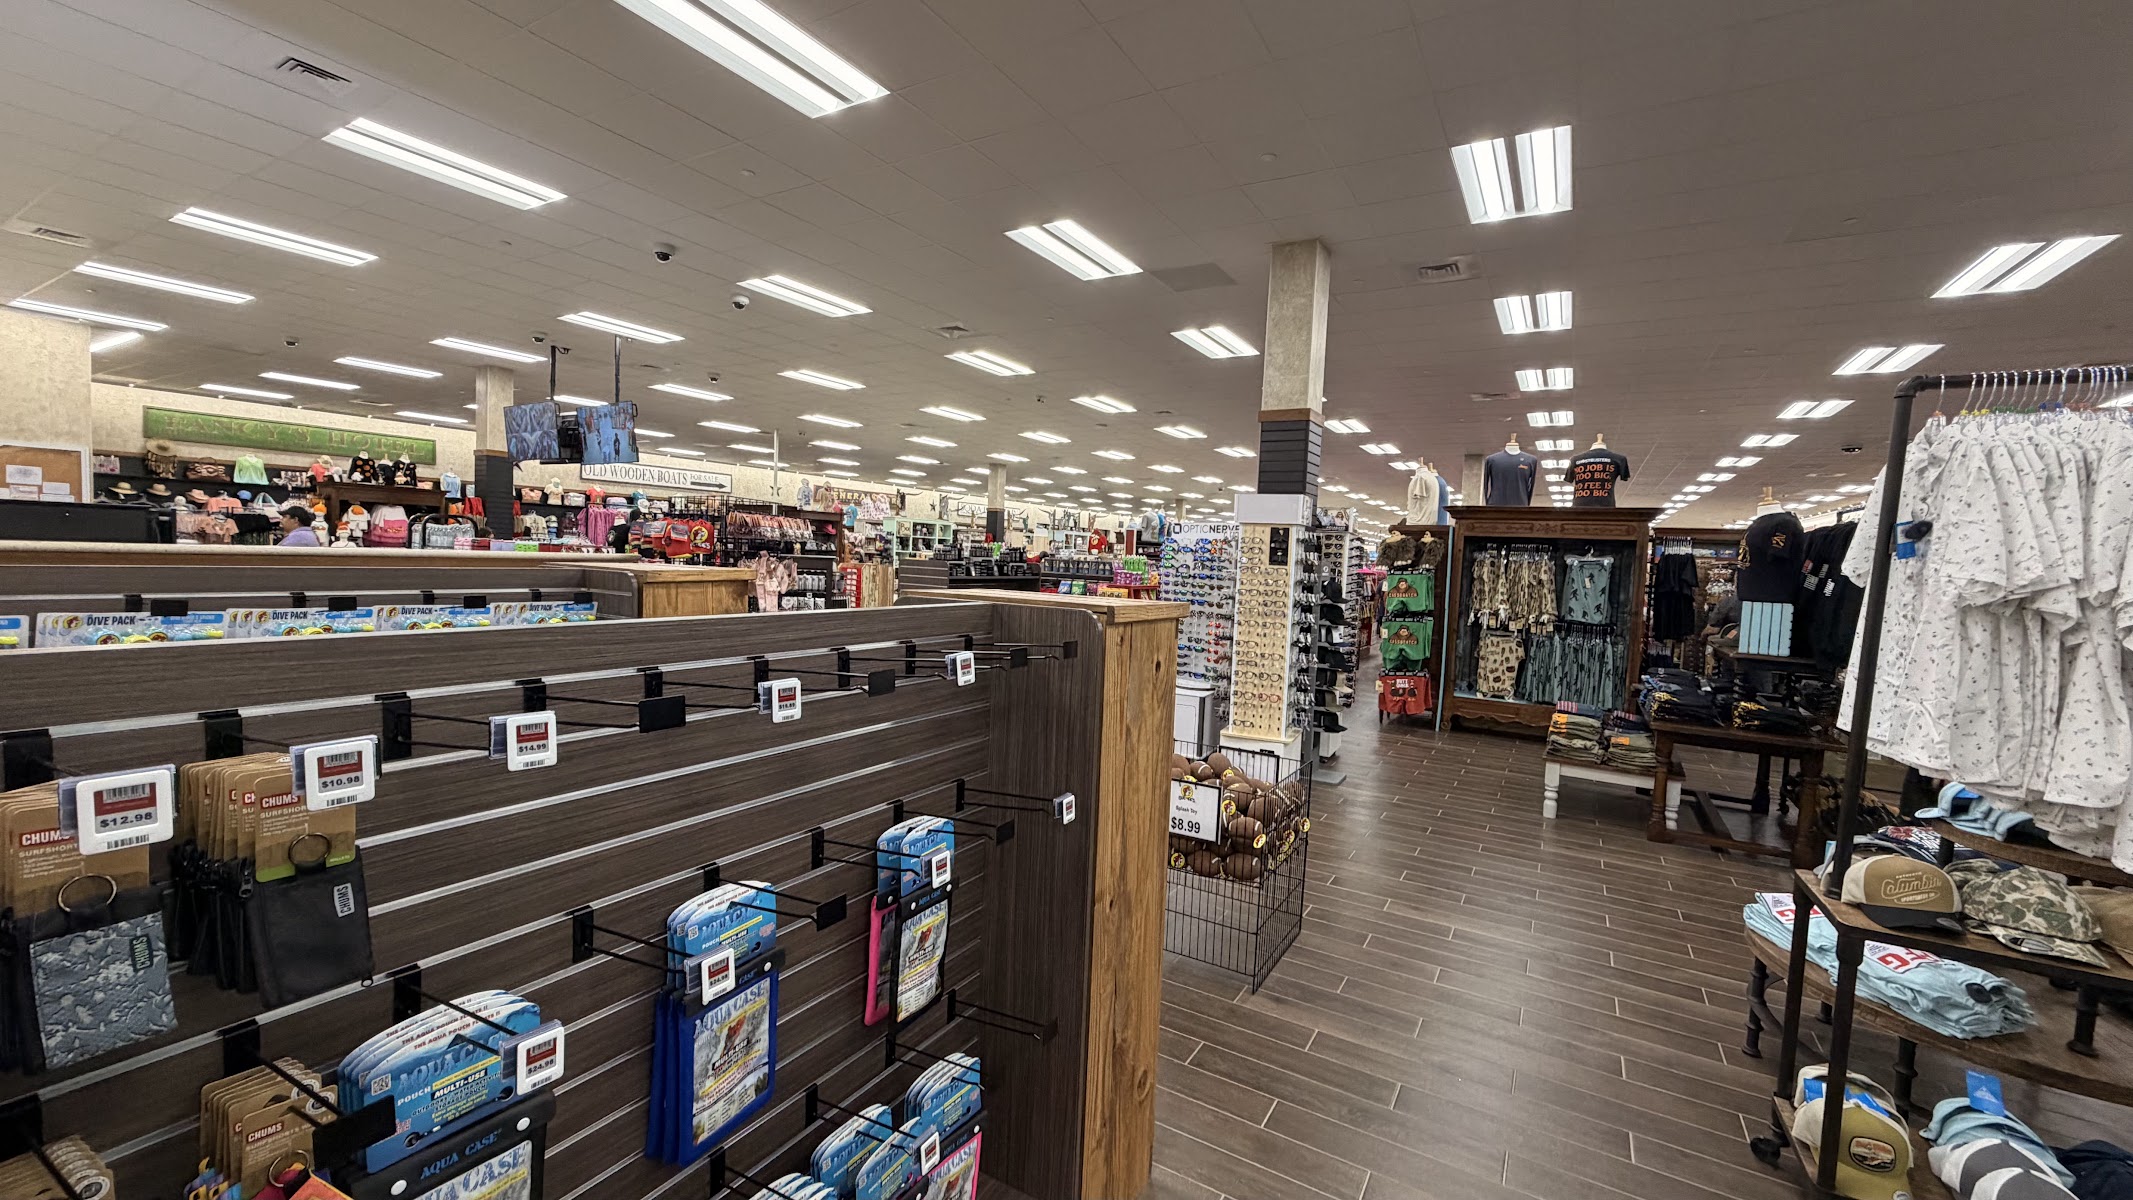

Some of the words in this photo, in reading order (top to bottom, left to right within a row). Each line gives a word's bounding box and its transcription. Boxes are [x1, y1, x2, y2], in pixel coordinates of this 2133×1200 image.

[583, 464, 607, 477] OLD
[610, 466, 655, 482] WOODEN
[658, 470, 688, 485] BOATS
[1575, 472, 1591, 480] TOO
[1585, 464, 1604, 472] JOB
[1606, 464, 1615, 472] IS
[272, 610, 289, 621] DIVE
[290, 610, 308, 620] PACK
[401, 605, 417, 615] DIVE
[418, 605, 433, 615] PACK
[86, 613, 110, 626] DIVE
[112, 612, 136, 625] PACK
[518, 742, 547, 753] $14.99
[321, 775, 360, 788] $10.98
[262, 794, 299, 808] CHUMS
[100, 812, 153, 828] $12.98
[1170, 816, 1201, 834] $8.99
[21, 829, 71, 846] CHUM
[18, 842, 78, 858] SURFSHORT
[1881, 874, 1942, 899] Columbia
[338, 885, 352, 914] CHUMS
[702, 938, 720, 949] POUCH
[133, 936, 151, 969] CHUMS
[414, 1041, 427, 1051] THE
[428, 1033, 447, 1044] AQUA
[448, 1022, 471, 1036] POUCH
[527, 1058, 555, 1075] $24.98
[434, 1069, 486, 1098] MULTI-USE
[397, 1085, 431, 1106] POUCH
[248, 1122, 283, 1143] CHUMS
[420, 1152, 460, 1180] AQUA
[464, 1131, 499, 1156] CASE
[462, 1146, 526, 1193] CASE
